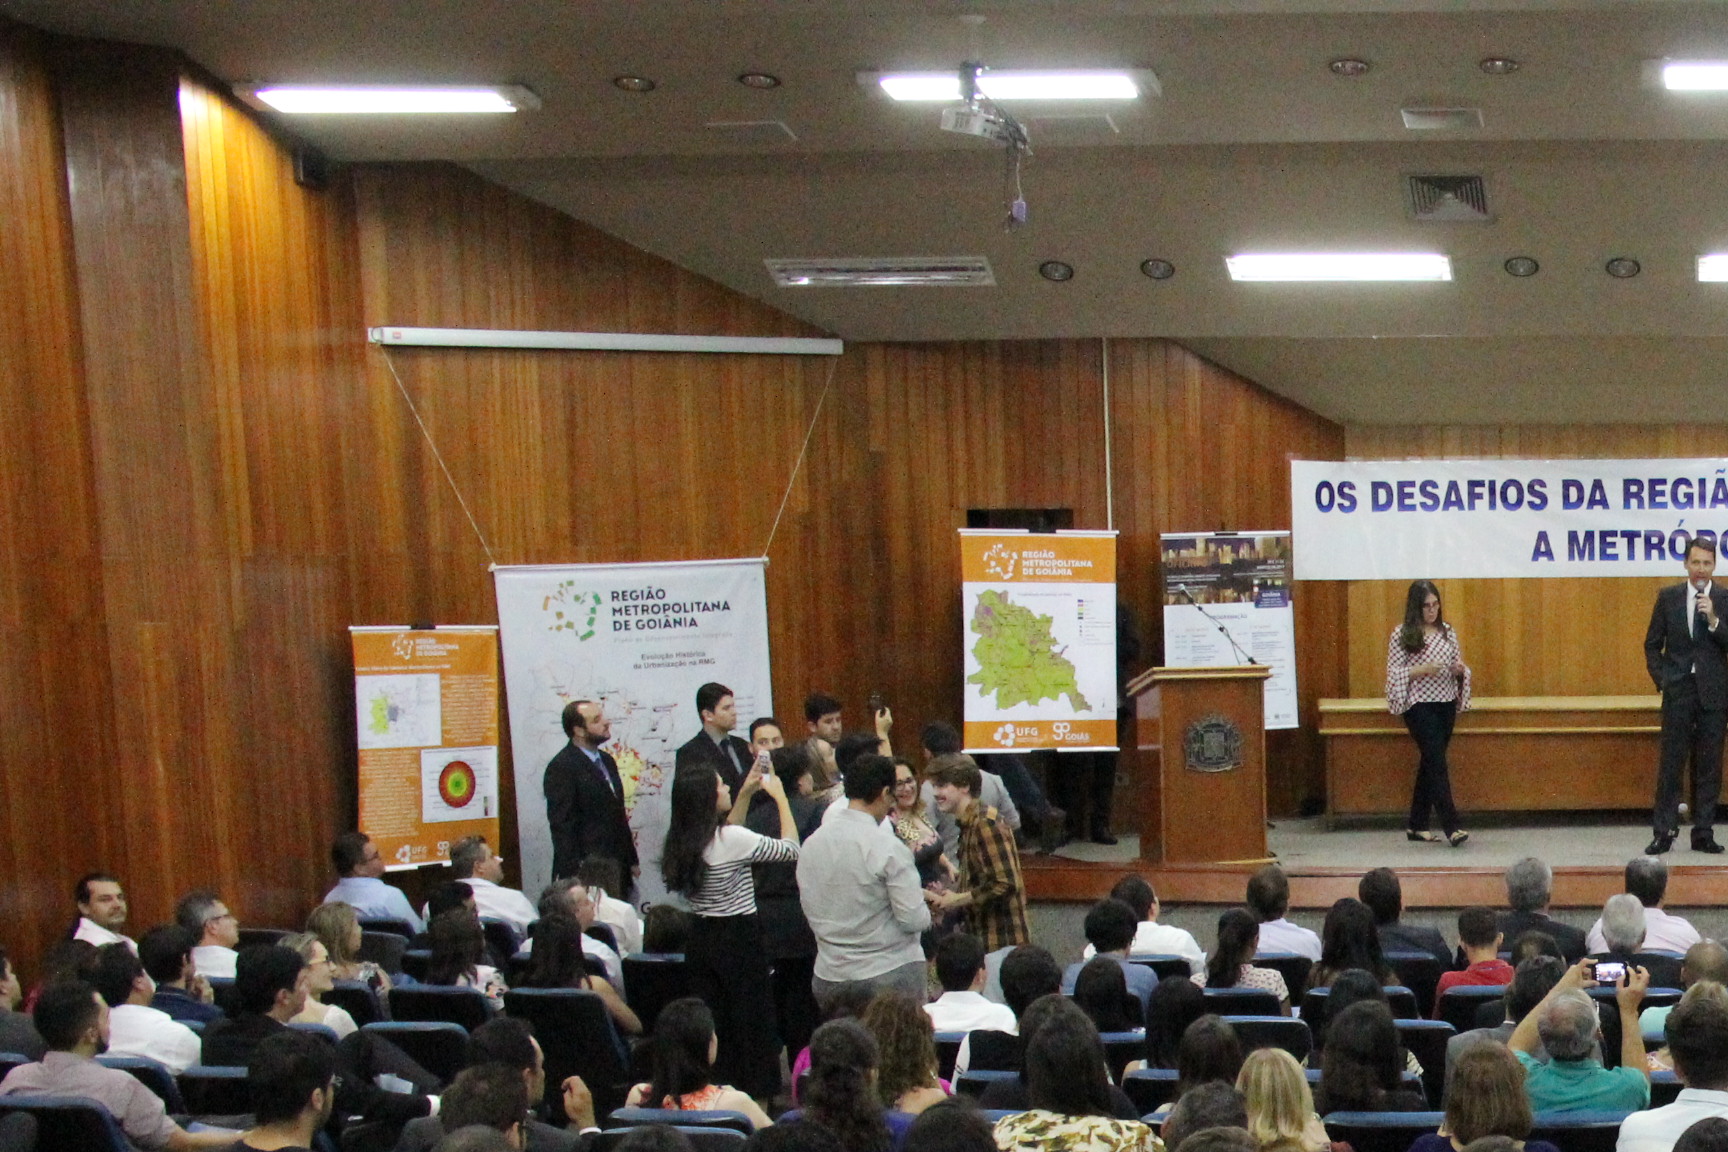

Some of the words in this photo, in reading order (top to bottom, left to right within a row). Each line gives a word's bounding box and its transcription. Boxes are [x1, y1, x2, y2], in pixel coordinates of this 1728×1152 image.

[1315, 480, 1357, 514] OS
[1371, 478, 1548, 513] DESAFIOS
[1562, 478, 1610, 511] DA
[1532, 529, 1555, 562] A
[1022, 549, 1055, 559] REGIÃO
[1022, 559, 1093, 568] METROPOLITANA
[1022, 567, 1034, 576] DE
[1035, 567, 1073, 576] GOIÂNIA
[611, 586, 666, 602] REGIÃO
[612, 600, 731, 617] METROPOLITANA
[613, 620, 631, 632] DE
[635, 614, 699, 631] GOIÂNIA
[1016, 727, 1038, 737] UFG
